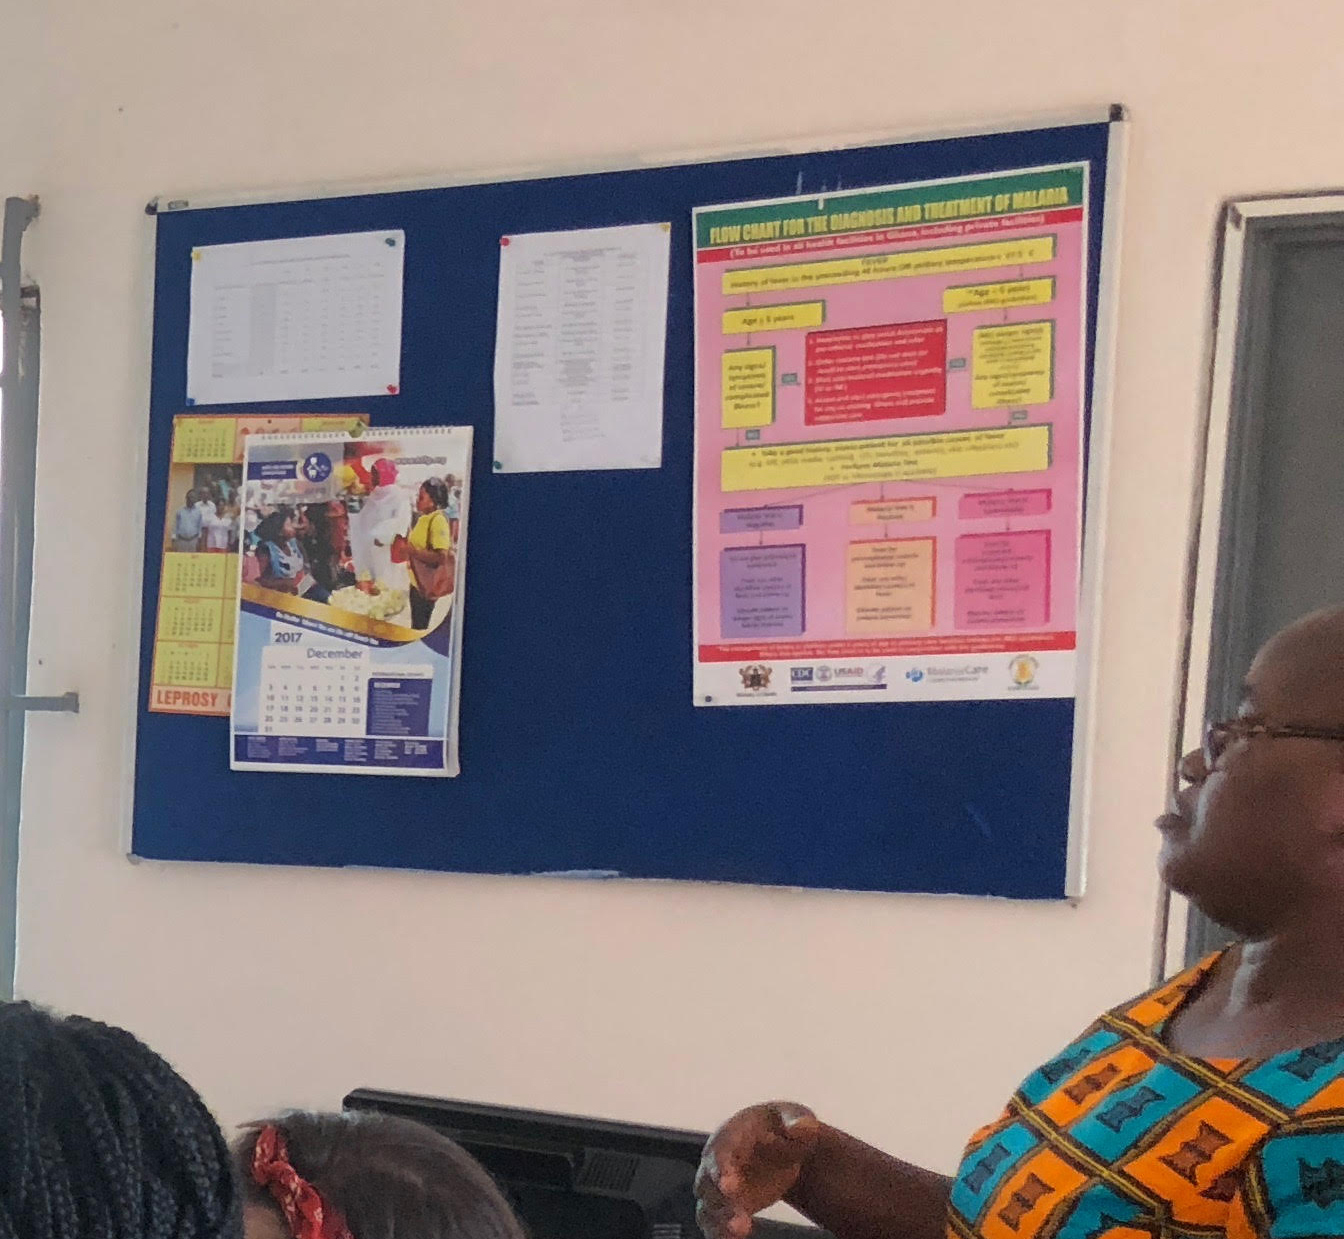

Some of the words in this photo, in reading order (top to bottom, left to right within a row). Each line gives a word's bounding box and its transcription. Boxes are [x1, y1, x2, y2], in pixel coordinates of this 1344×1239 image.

[710, 225, 740, 244] FLOW
[743, 220, 781, 240] CHART
[783, 218, 805, 236] FOR
[807, 215, 828, 233] THE
[831, 208, 893, 230] DIAGNOSIS
[897, 204, 921, 223] AND
[924, 196, 992, 220] TREATMENT
[995, 194, 1009, 212] OF
[1013, 187, 1068, 209] MALARIA
[275, 632, 303, 643] 2017
[307, 648, 362, 660] December
[834, 667, 864, 678] USAID
[157, 690, 219, 707] LEPROSY
